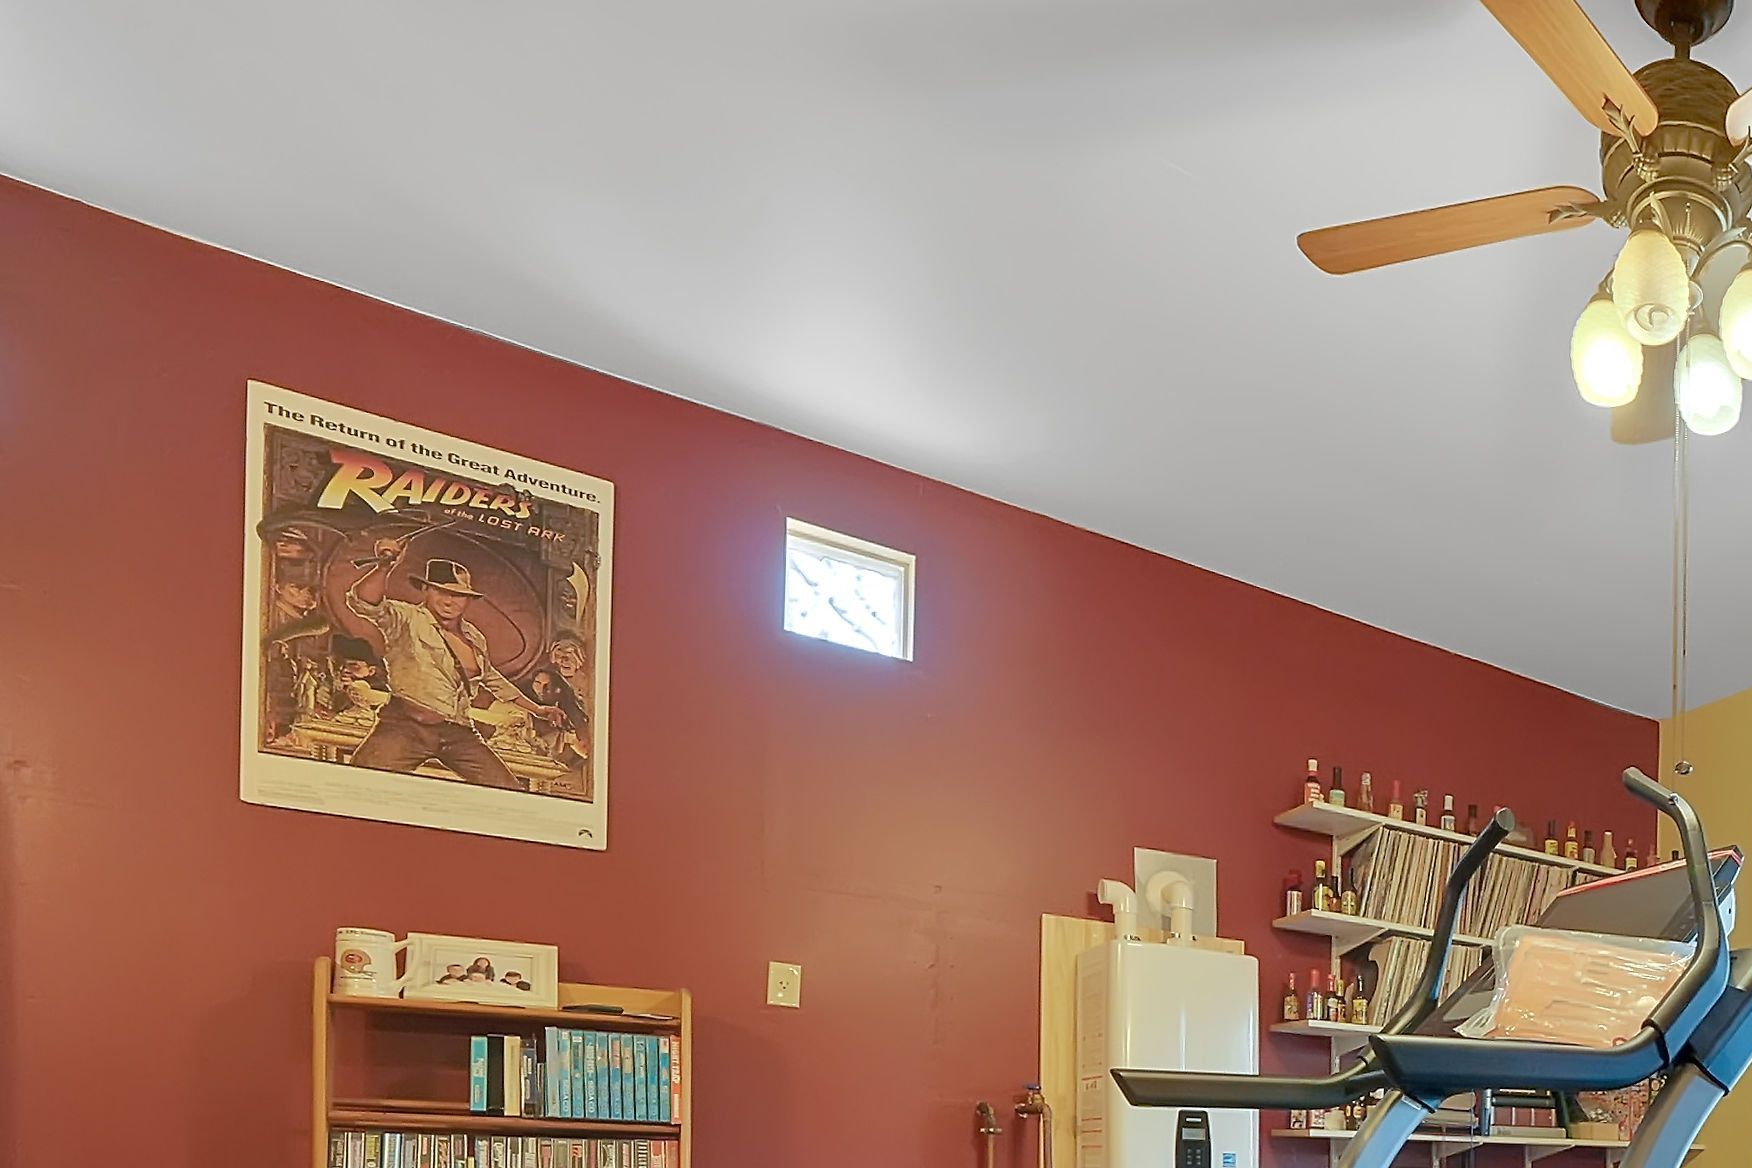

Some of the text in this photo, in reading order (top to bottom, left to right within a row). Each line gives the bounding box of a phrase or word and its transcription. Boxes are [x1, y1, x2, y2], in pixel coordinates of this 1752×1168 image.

[263, 400, 602, 505] The Return of the Great Adventure.
[317, 450, 535, 519] RAIDERS
[477, 513, 523, 532] LOST
[527, 526, 567, 544] ARK
